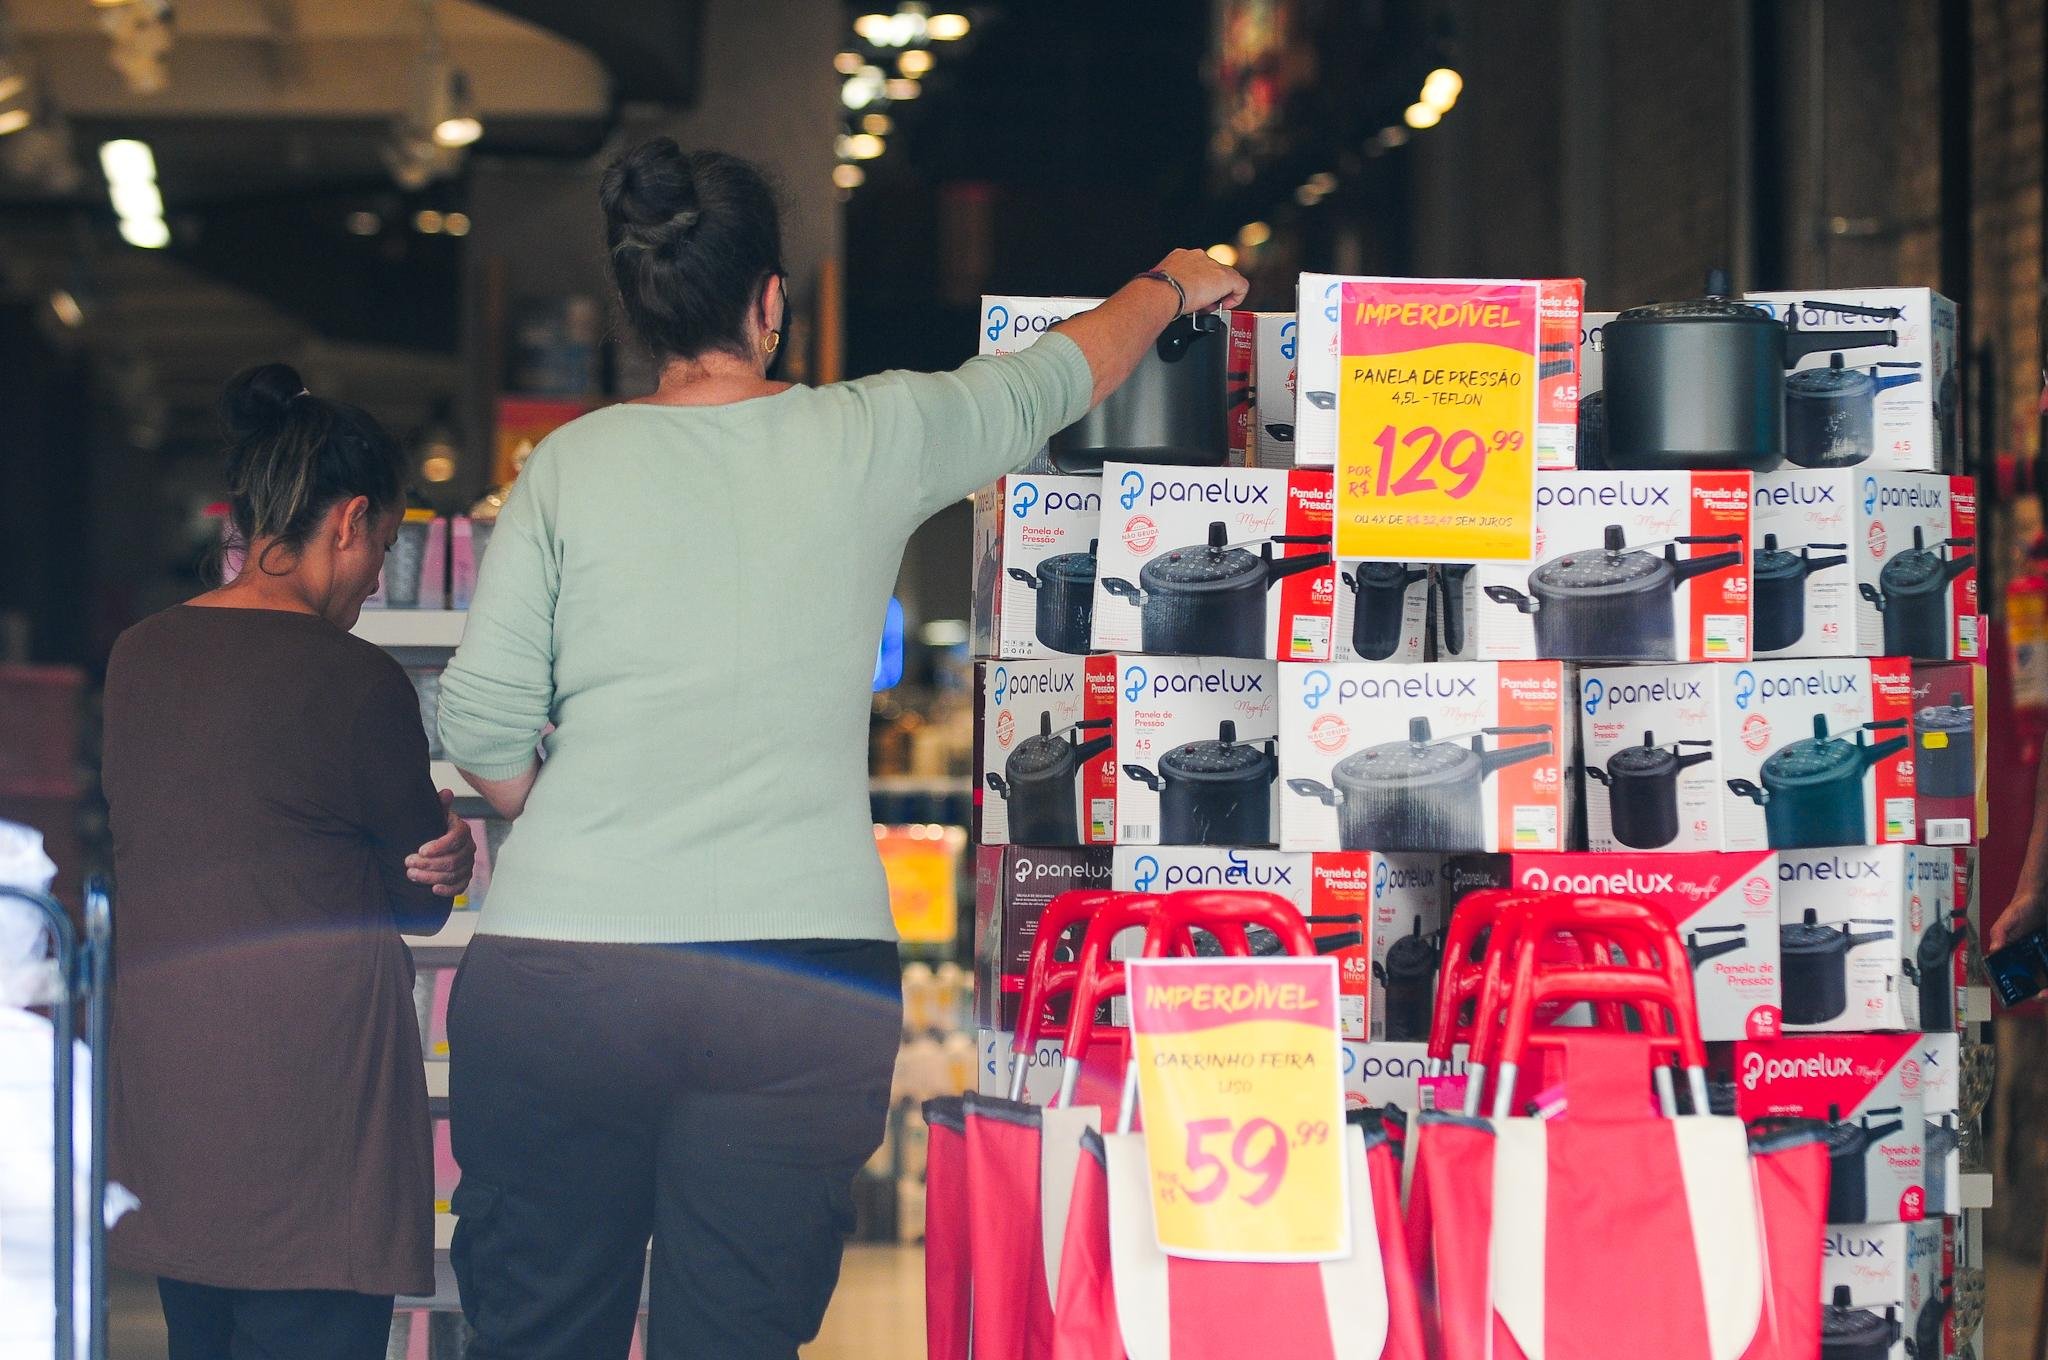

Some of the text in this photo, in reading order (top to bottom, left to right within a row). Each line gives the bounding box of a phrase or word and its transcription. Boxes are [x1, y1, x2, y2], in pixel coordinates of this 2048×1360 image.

[1356, 300, 1521, 330] IMPERDÍVEL
[1540, 308, 1579, 318] ressão
[1355, 368, 1521, 388] PANELA DE PRESSÃO
[1392, 391, 1420, 406] 4,5L
[1432, 391, 1483, 406] TEFLON
[1347, 465, 1372, 479] POR
[1150, 478, 1269, 507] panelux
[1290, 487, 1333, 499] Panela d
[1349, 480, 1370, 498] R$
[1537, 480, 1670, 512] panelux
[1693, 487, 1748, 499] Panela de
[1755, 481, 1835, 507] nelux
[1881, 482, 1942, 512] panelux
[1299, 499, 1333, 510] Pressã
[1354, 514, 1369, 524] OU
[1371, 514, 1385, 525] 4X
[1388, 514, 1403, 525] DE
[1455, 515, 1476, 527] SEM
[1479, 516, 1513, 528] JUROS
[1022, 526, 1064, 536] Panela de
[1022, 535, 1056, 544] Pressão
[1312, 578, 1333, 594] 4,5
[1311, 592, 1333, 602] litros
[1010, 667, 1075, 700] panelux
[1086, 672, 1115, 683] Panela de
[1154, 669, 1262, 698] panelux
[1501, 677, 1557, 689] Panela de
[1092, 683, 1115, 694] Pressão
[1339, 672, 1476, 704] panelux
[1512, 688, 1558, 700] Pressão
[1608, 677, 1701, 710] panelux
[1762, 670, 1857, 703] panelux
[1134, 710, 1173, 719] Panela de
[1134, 719, 1165, 728] Pressão
[1102, 761, 1115, 777] 4,5
[1036, 861, 1113, 880] panelux
[1315, 867, 1367, 879] Panela de
[1779, 856, 1880, 882] anelux
[1325, 879, 1367, 890] Pressão
[1389, 864, 1435, 894] panelux
[1344, 957, 1366, 973] 4,5
[1714, 963, 1774, 975] Panela de
[1343, 971, 1365, 980] litros
[1728, 974, 1774, 986] Pressão
[1146, 981, 1319, 1013] IMPERDÍVEL
[1154, 1053, 1315, 1070] CARRINHO FEIRA
[1765, 1052, 1853, 1084] panelux
[1823, 1232, 1884, 1257] elux
